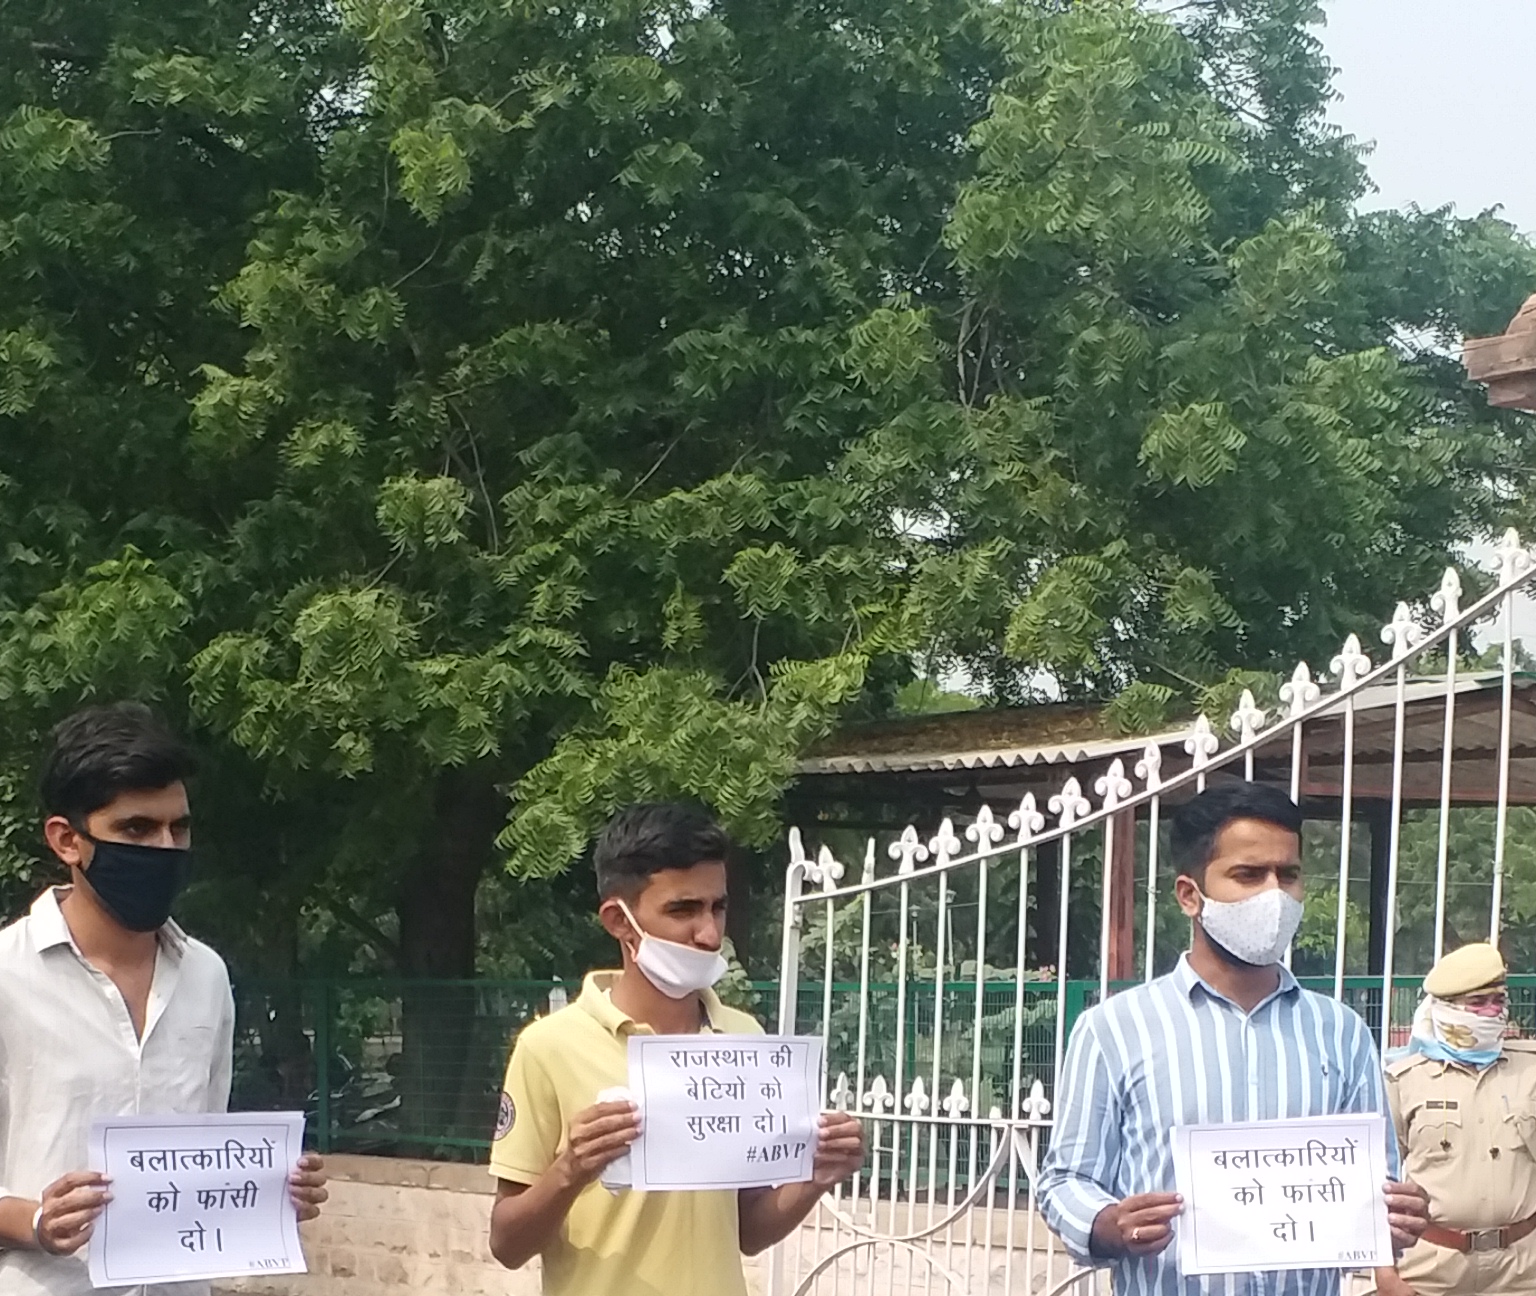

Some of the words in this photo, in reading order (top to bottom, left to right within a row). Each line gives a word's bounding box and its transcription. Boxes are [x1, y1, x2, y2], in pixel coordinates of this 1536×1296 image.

[670, 1050, 758, 1067] राजस्थान
[769, 1045, 793, 1067] की
[759, 1077, 782, 1100] को
[686, 1116, 740, 1141] सुरक्षा
[127, 1138, 276, 1172] बलात्कारियों
[746, 1143, 806, 1162] #ABVP
[1211, 1138, 1359, 1169] बलात्कारियों
[147, 1182, 180, 1212] को
[197, 1180, 259, 1210] फांसी
[1230, 1178, 1264, 1205] को
[1281, 1177, 1345, 1203] फांसी
